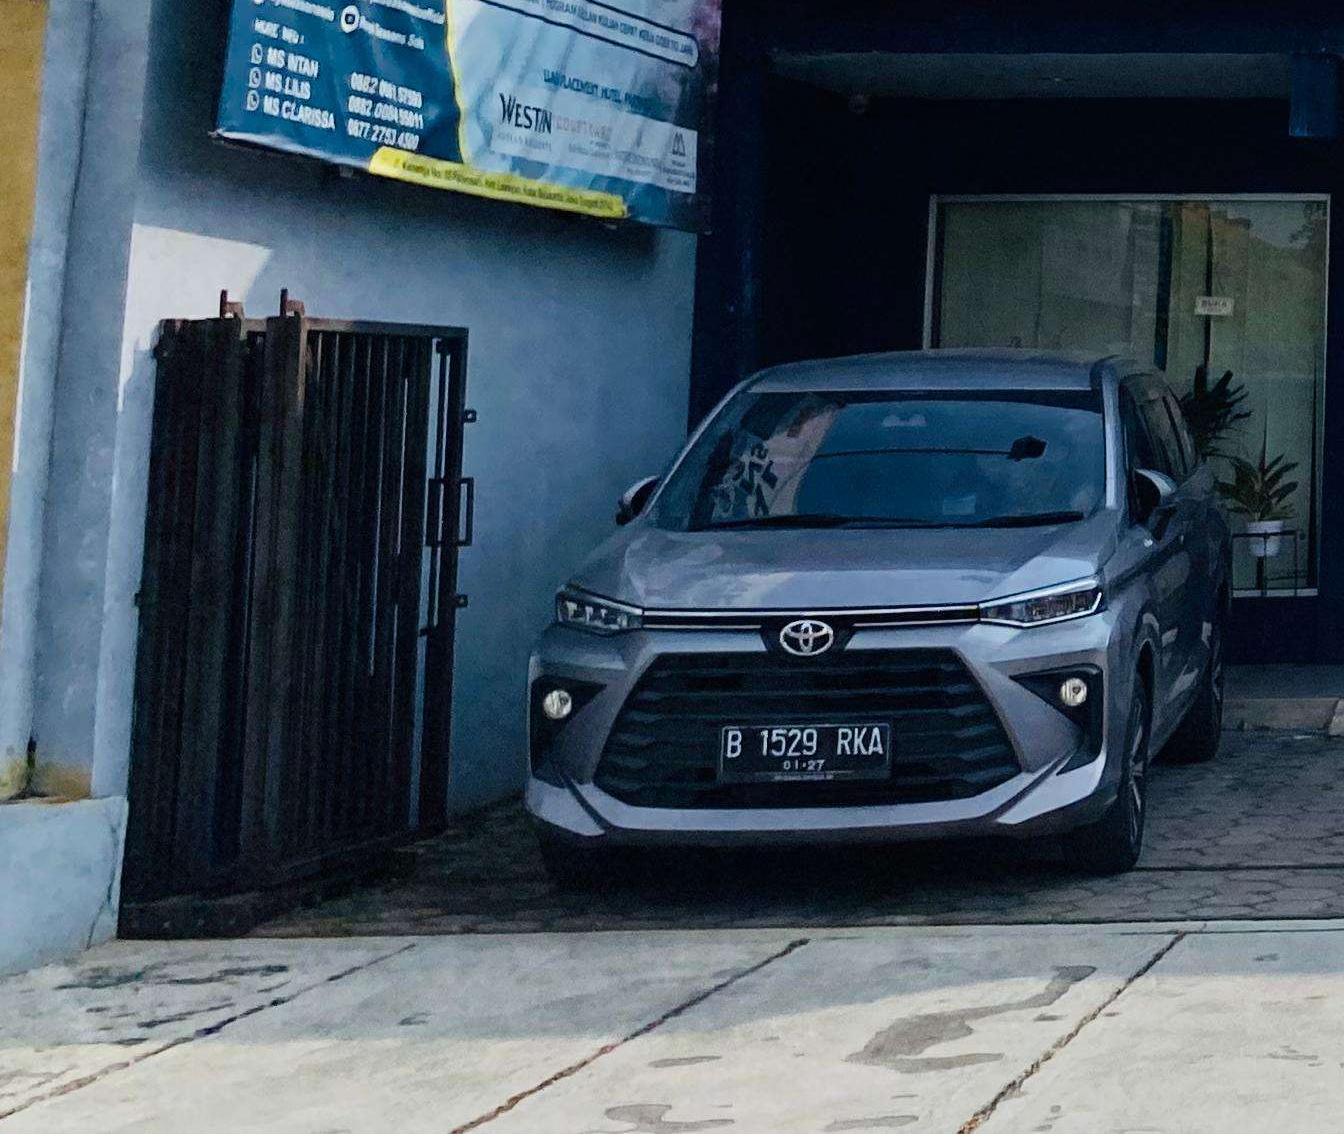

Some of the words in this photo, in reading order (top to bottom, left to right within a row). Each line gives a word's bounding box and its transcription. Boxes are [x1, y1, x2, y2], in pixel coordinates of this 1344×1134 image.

[267, 47, 285, 69] MS
[265, 71, 282, 93] MS
[263, 95, 280, 116] MS
[282, 100, 335, 130] CLARISSA
[726, 730, 742, 758] B
[760, 728, 818, 756] 1529
[836, 727, 884, 756] RKA
